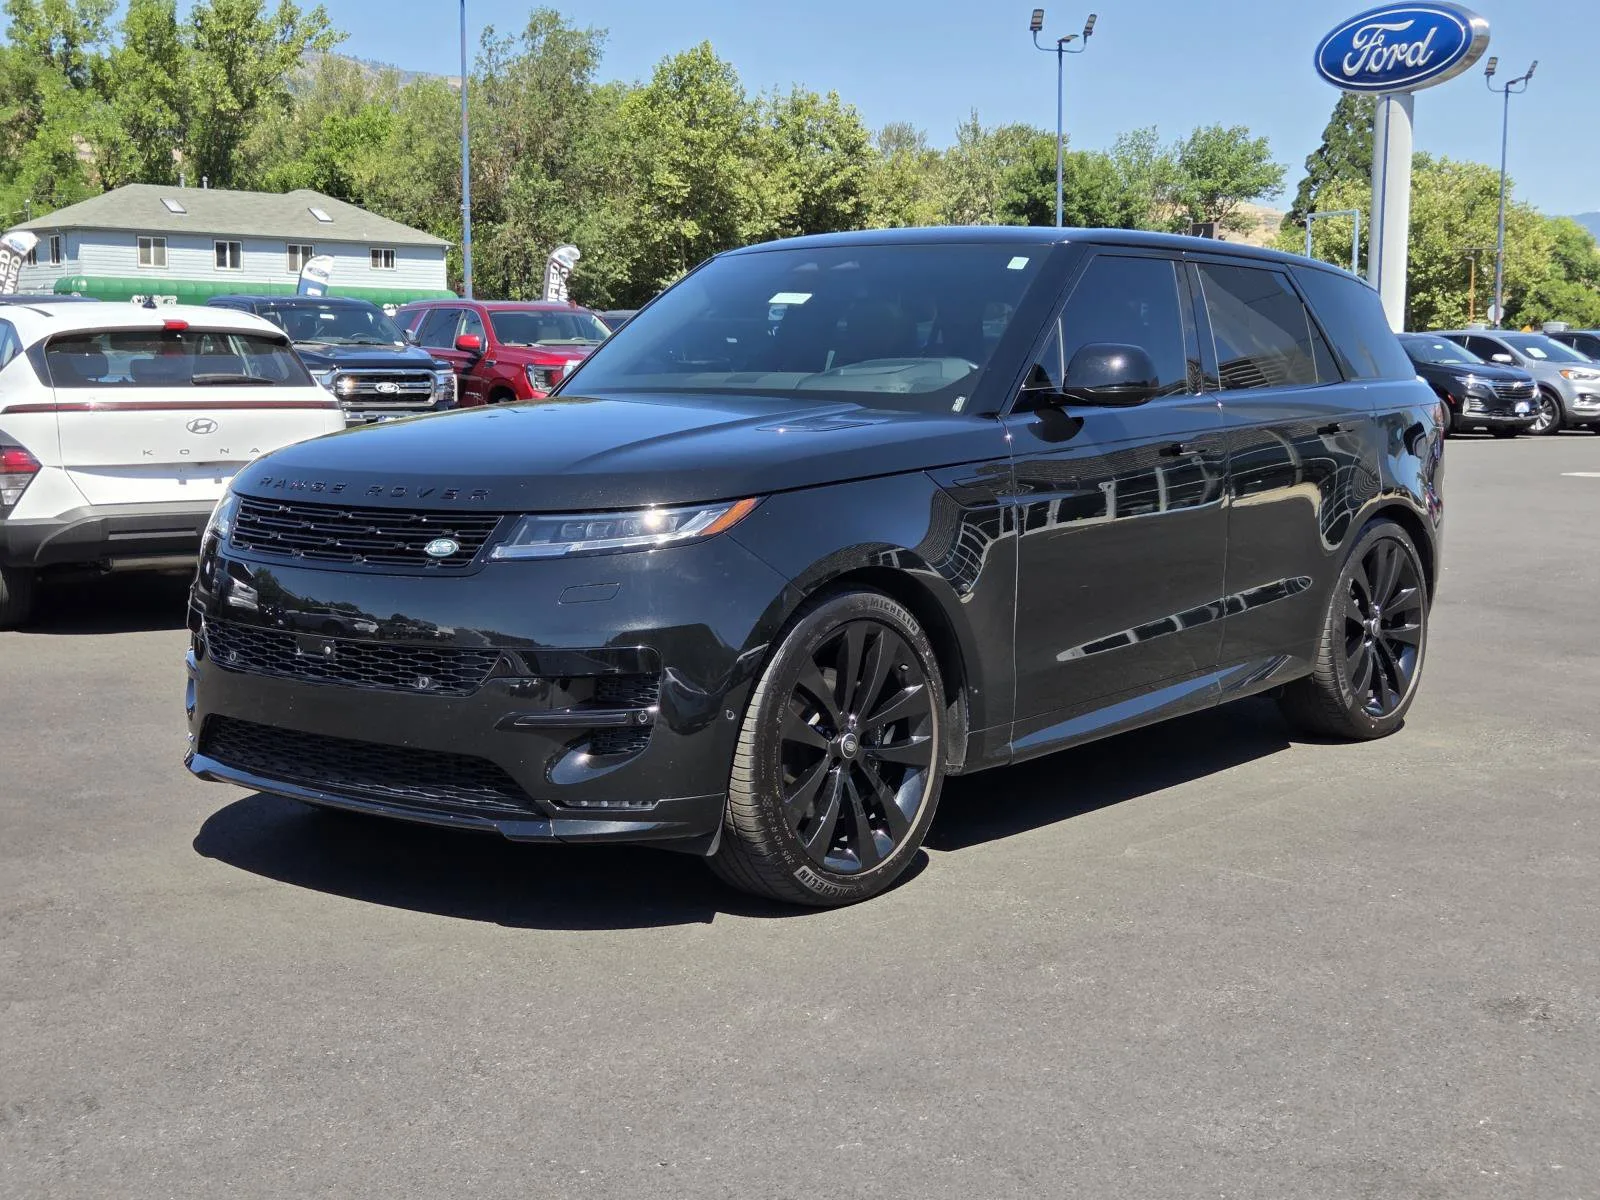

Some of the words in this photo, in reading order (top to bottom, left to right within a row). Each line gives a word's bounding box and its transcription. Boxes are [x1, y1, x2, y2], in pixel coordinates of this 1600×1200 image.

[1343, 20, 1437, 76] Ford
[259, 476, 349, 494] RANGE
[364, 484, 491, 501] ROVER
[869, 596, 919, 634] MICHELIN
